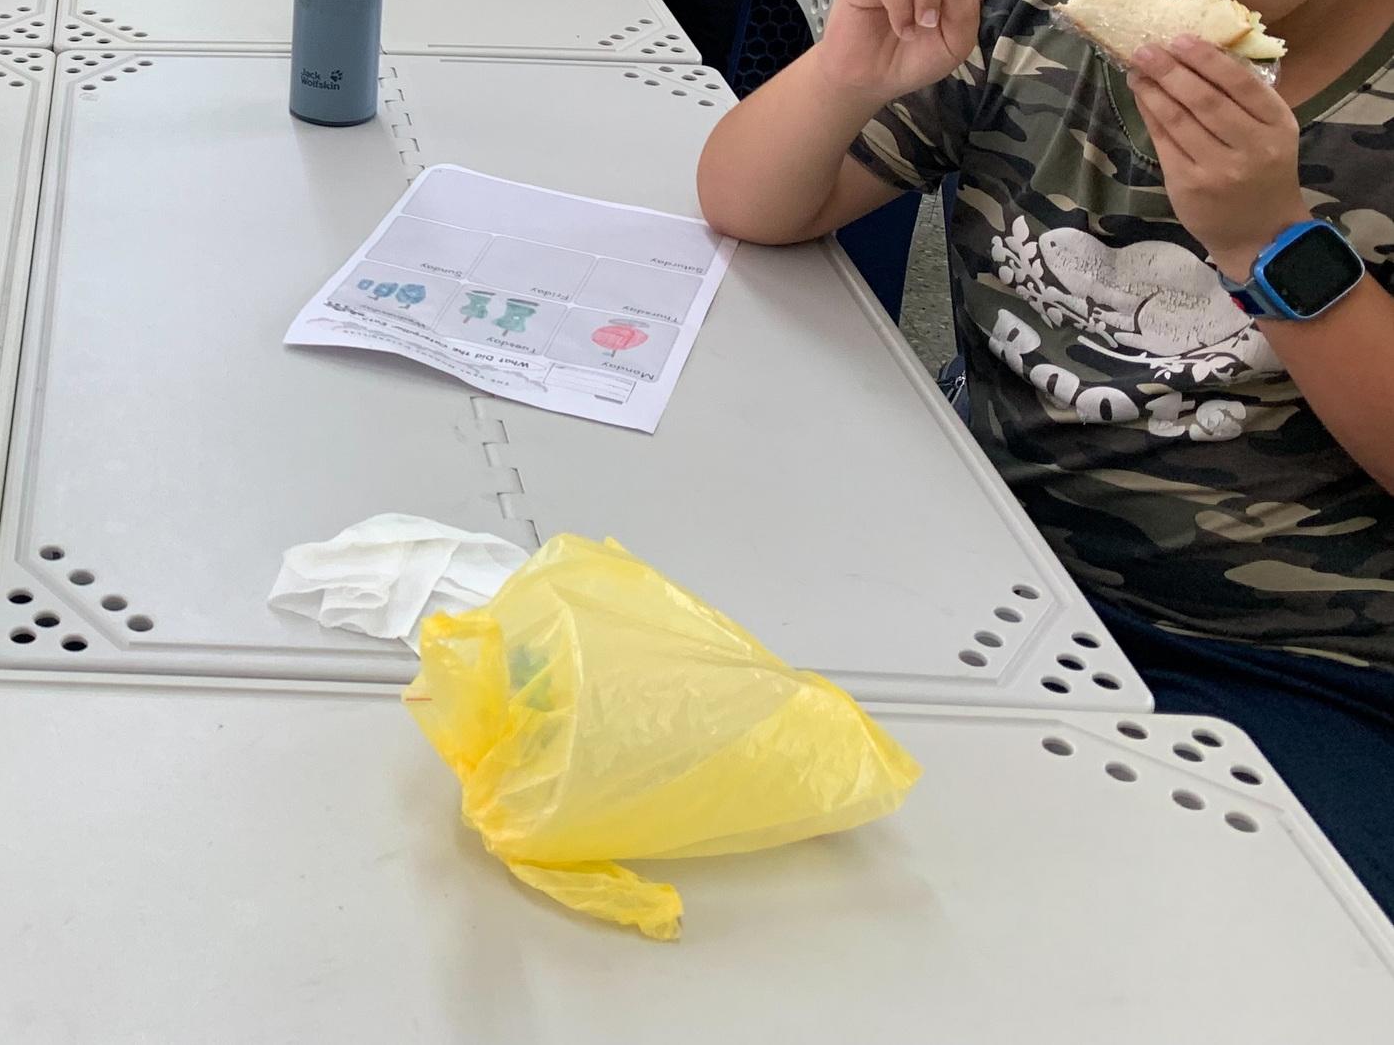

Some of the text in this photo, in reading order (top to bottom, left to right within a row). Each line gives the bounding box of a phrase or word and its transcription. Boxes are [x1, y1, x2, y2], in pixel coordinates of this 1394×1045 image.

[301, 68, 320, 79] Jack
[301, 76, 340, 90] Wolfskin
[420, 261, 463, 279] Sunday
[651, 257, 705, 275] Saturday
[531, 285, 570, 301] Friday
[623, 304, 680, 324] Thursday
[486, 334, 537, 354] Tuesday
[474, 351, 494, 363] Did
[498, 357, 531, 369] What
[601, 360, 656, 381] Monday
